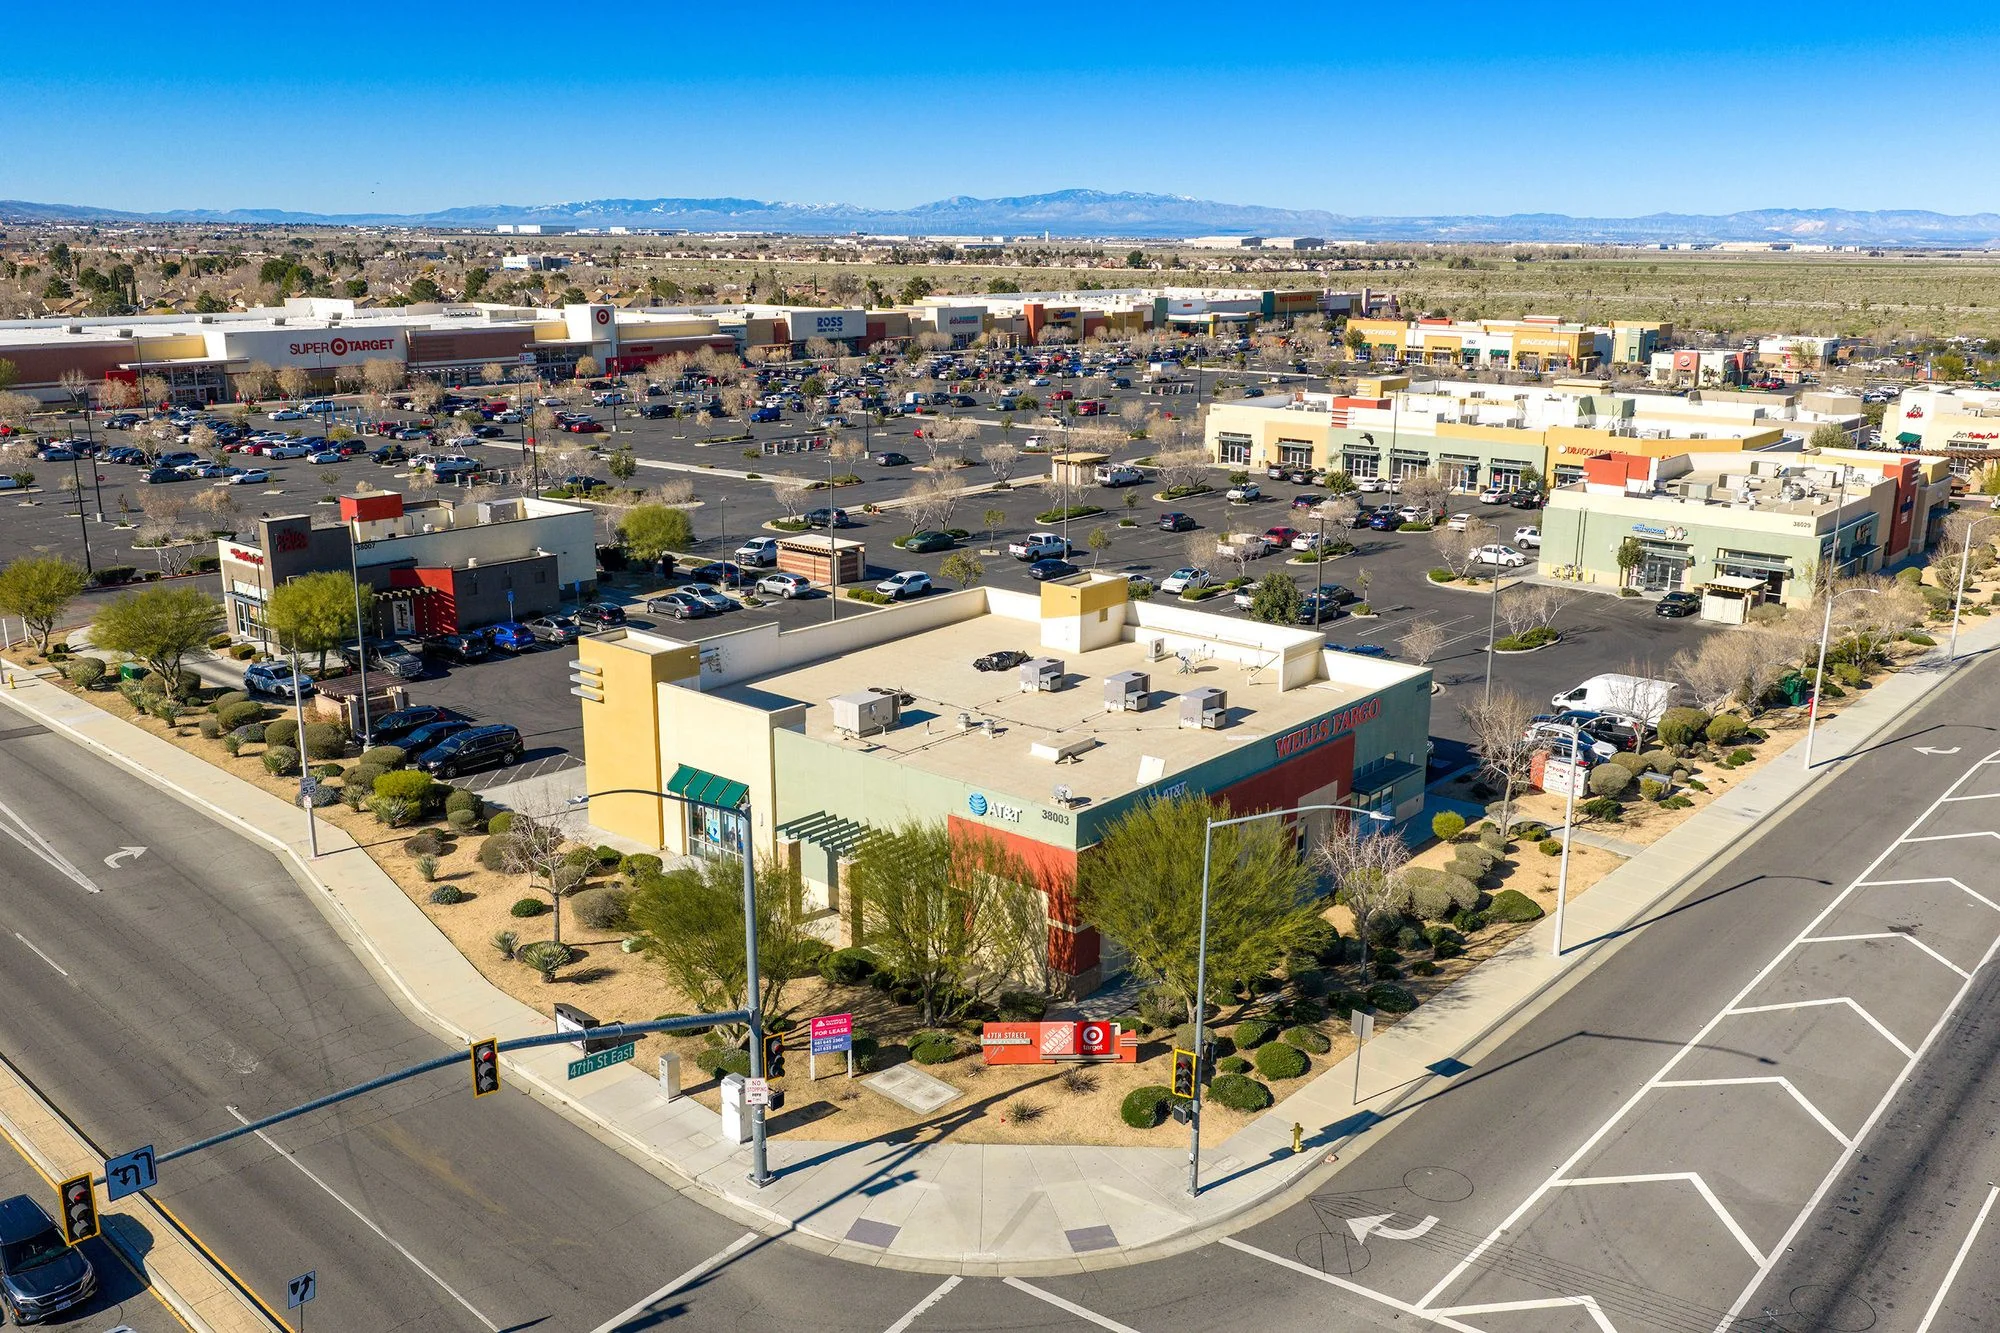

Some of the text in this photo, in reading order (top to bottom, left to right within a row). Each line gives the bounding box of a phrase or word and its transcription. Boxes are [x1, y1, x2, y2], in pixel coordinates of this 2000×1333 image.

[817, 316, 843, 327] ROSS
[289, 339, 394, 355] SUPER TARGET
[1567, 446, 1597, 456] DRAGON
[1275, 698, 1381, 758] WELLS FARGO
[303, 786, 315, 794] 55
[1162, 781, 1187, 800] AT&T
[990, 802, 1022, 822] AT&T
[1042, 809, 1069, 825] 38003
[1041, 1024, 1072, 1054] HOME
[1052, 1034, 1073, 1054] DEPOT
[570, 1045, 633, 1077] 47th St East
